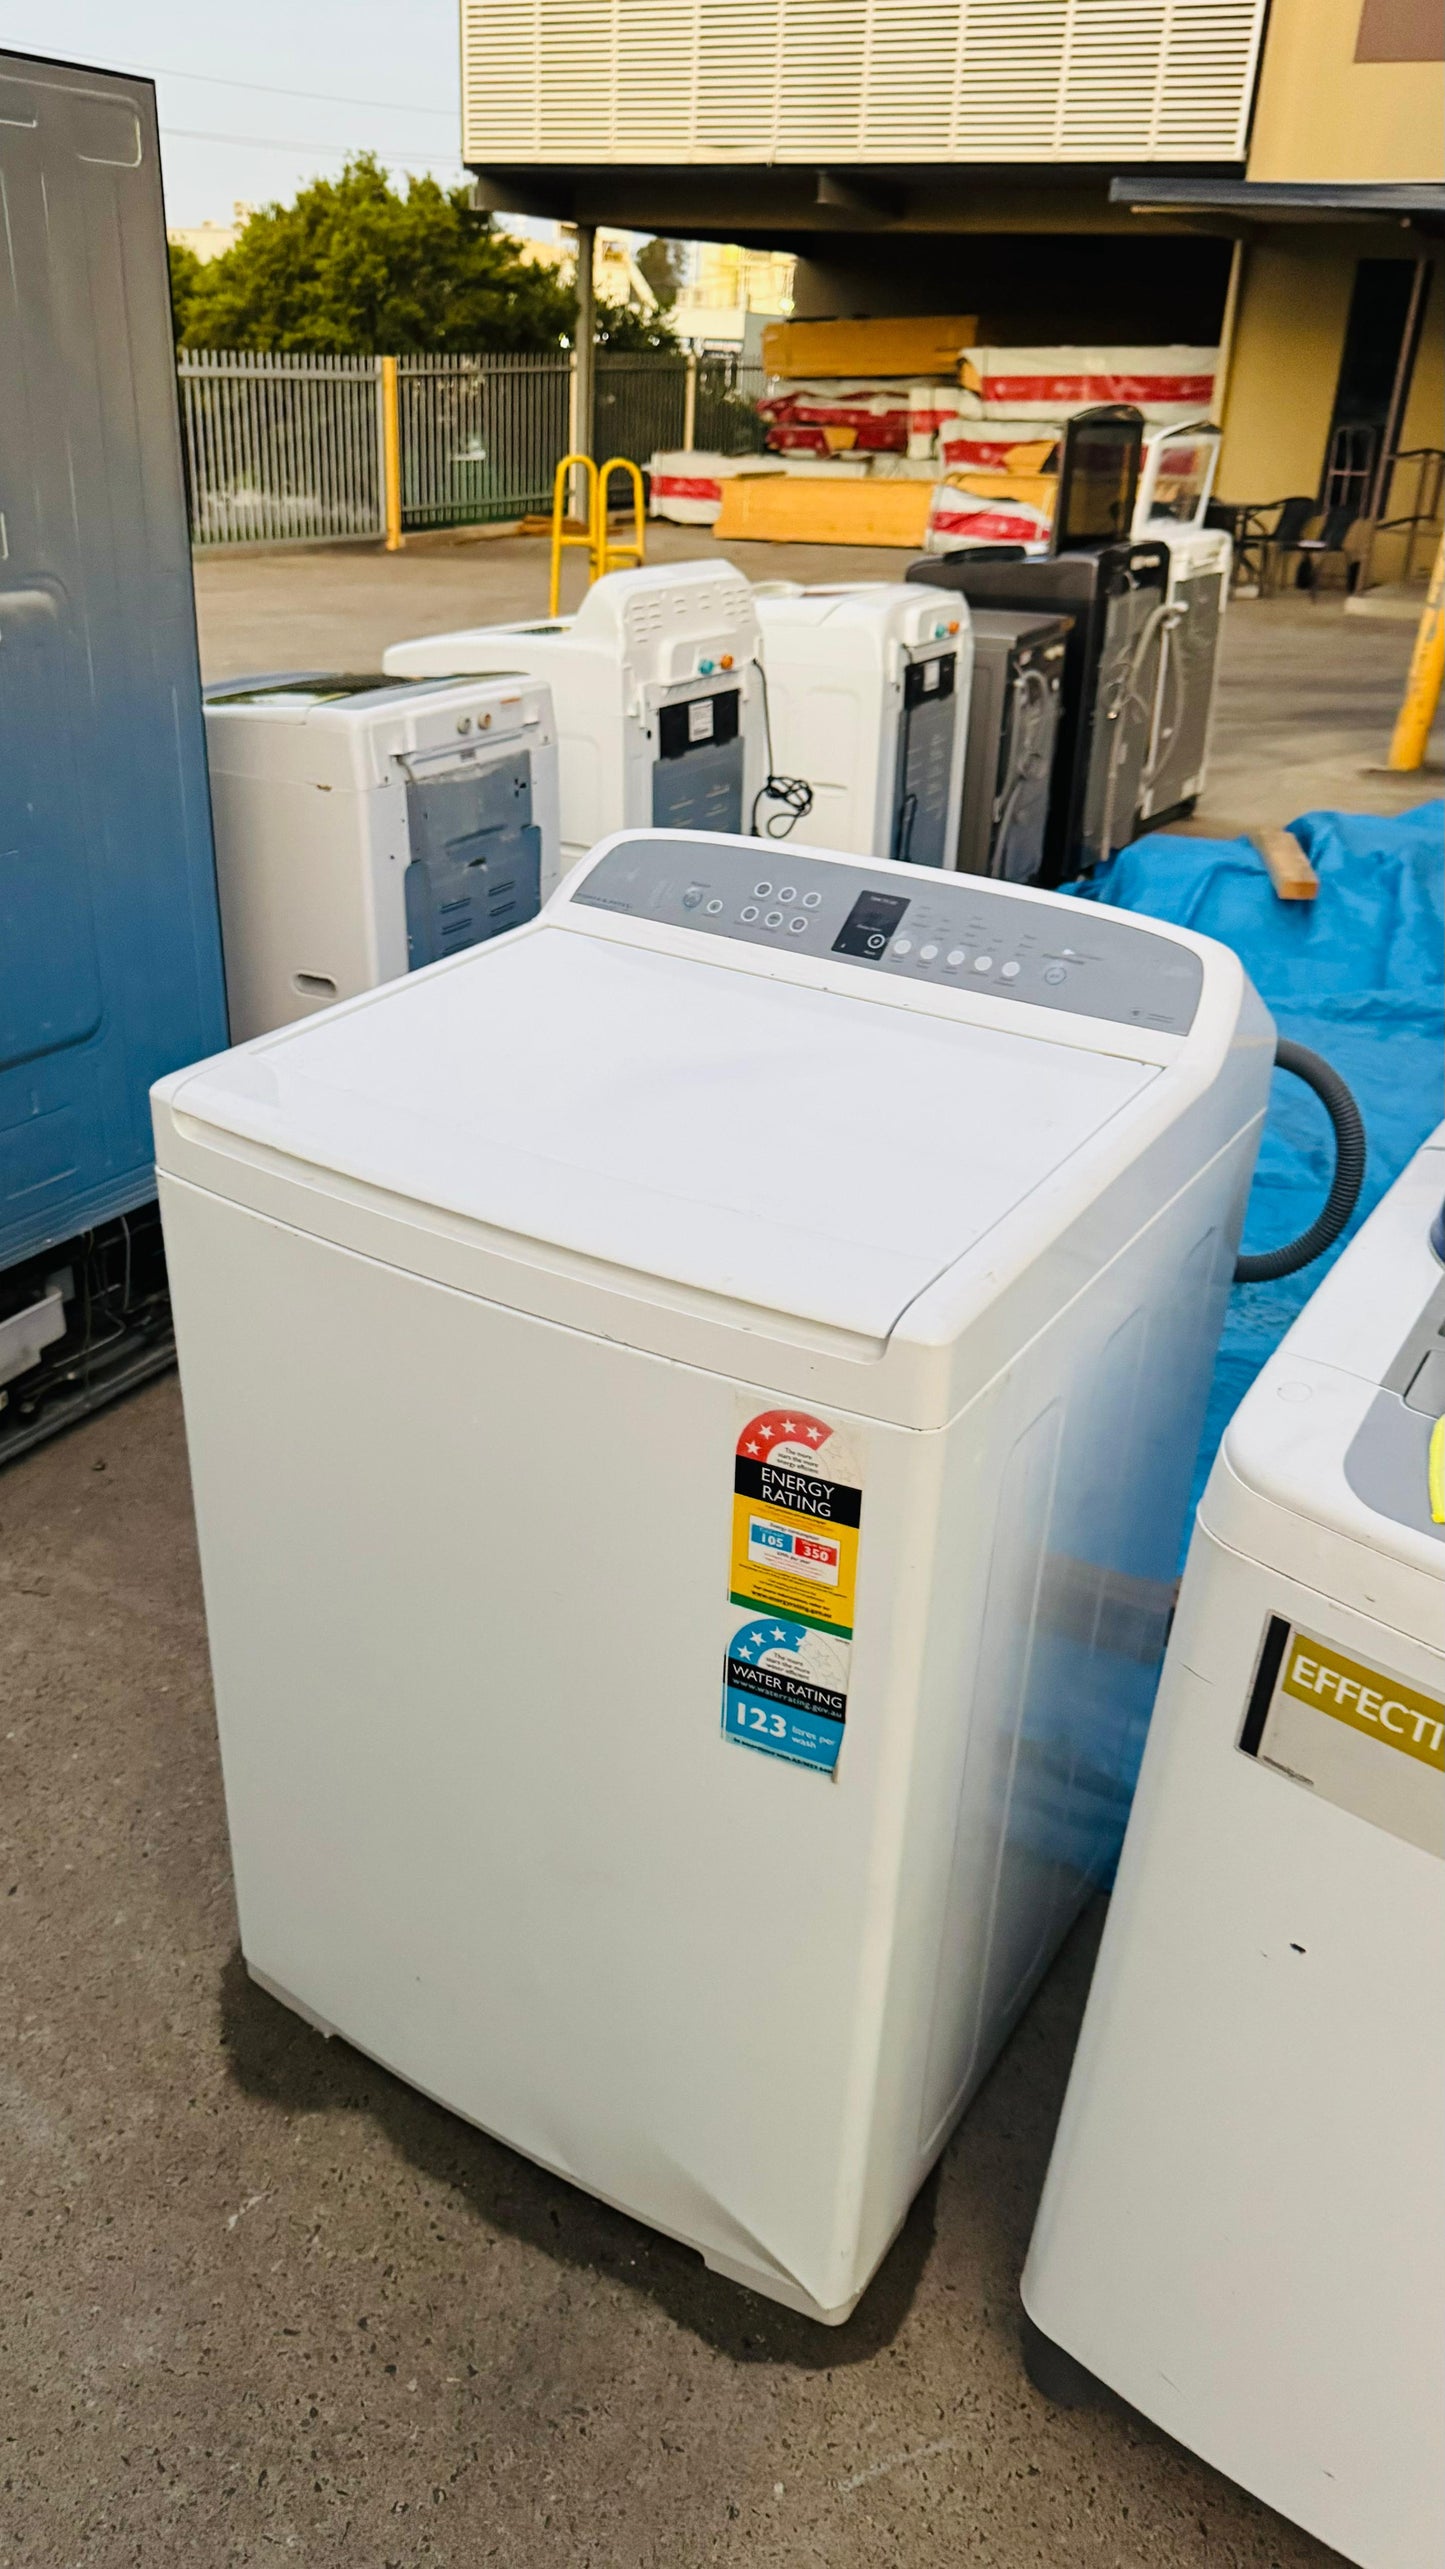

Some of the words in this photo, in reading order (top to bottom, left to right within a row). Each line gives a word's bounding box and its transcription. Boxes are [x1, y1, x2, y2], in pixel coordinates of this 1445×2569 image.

[761, 1467, 835, 1500] ENERGY
[762, 1485, 831, 1517] RATING
[761, 1533, 784, 1548] 105
[803, 1546, 829, 1562] 350
[732, 1663, 782, 1690] WATER
[786, 1682, 843, 1709] RATING
[732, 1678, 842, 1718] www.waterrating.gov.au
[1290, 1654, 1445, 1751] EFFECTI
[737, 1701, 787, 1738] 123
[791, 1736, 817, 1749] wash
